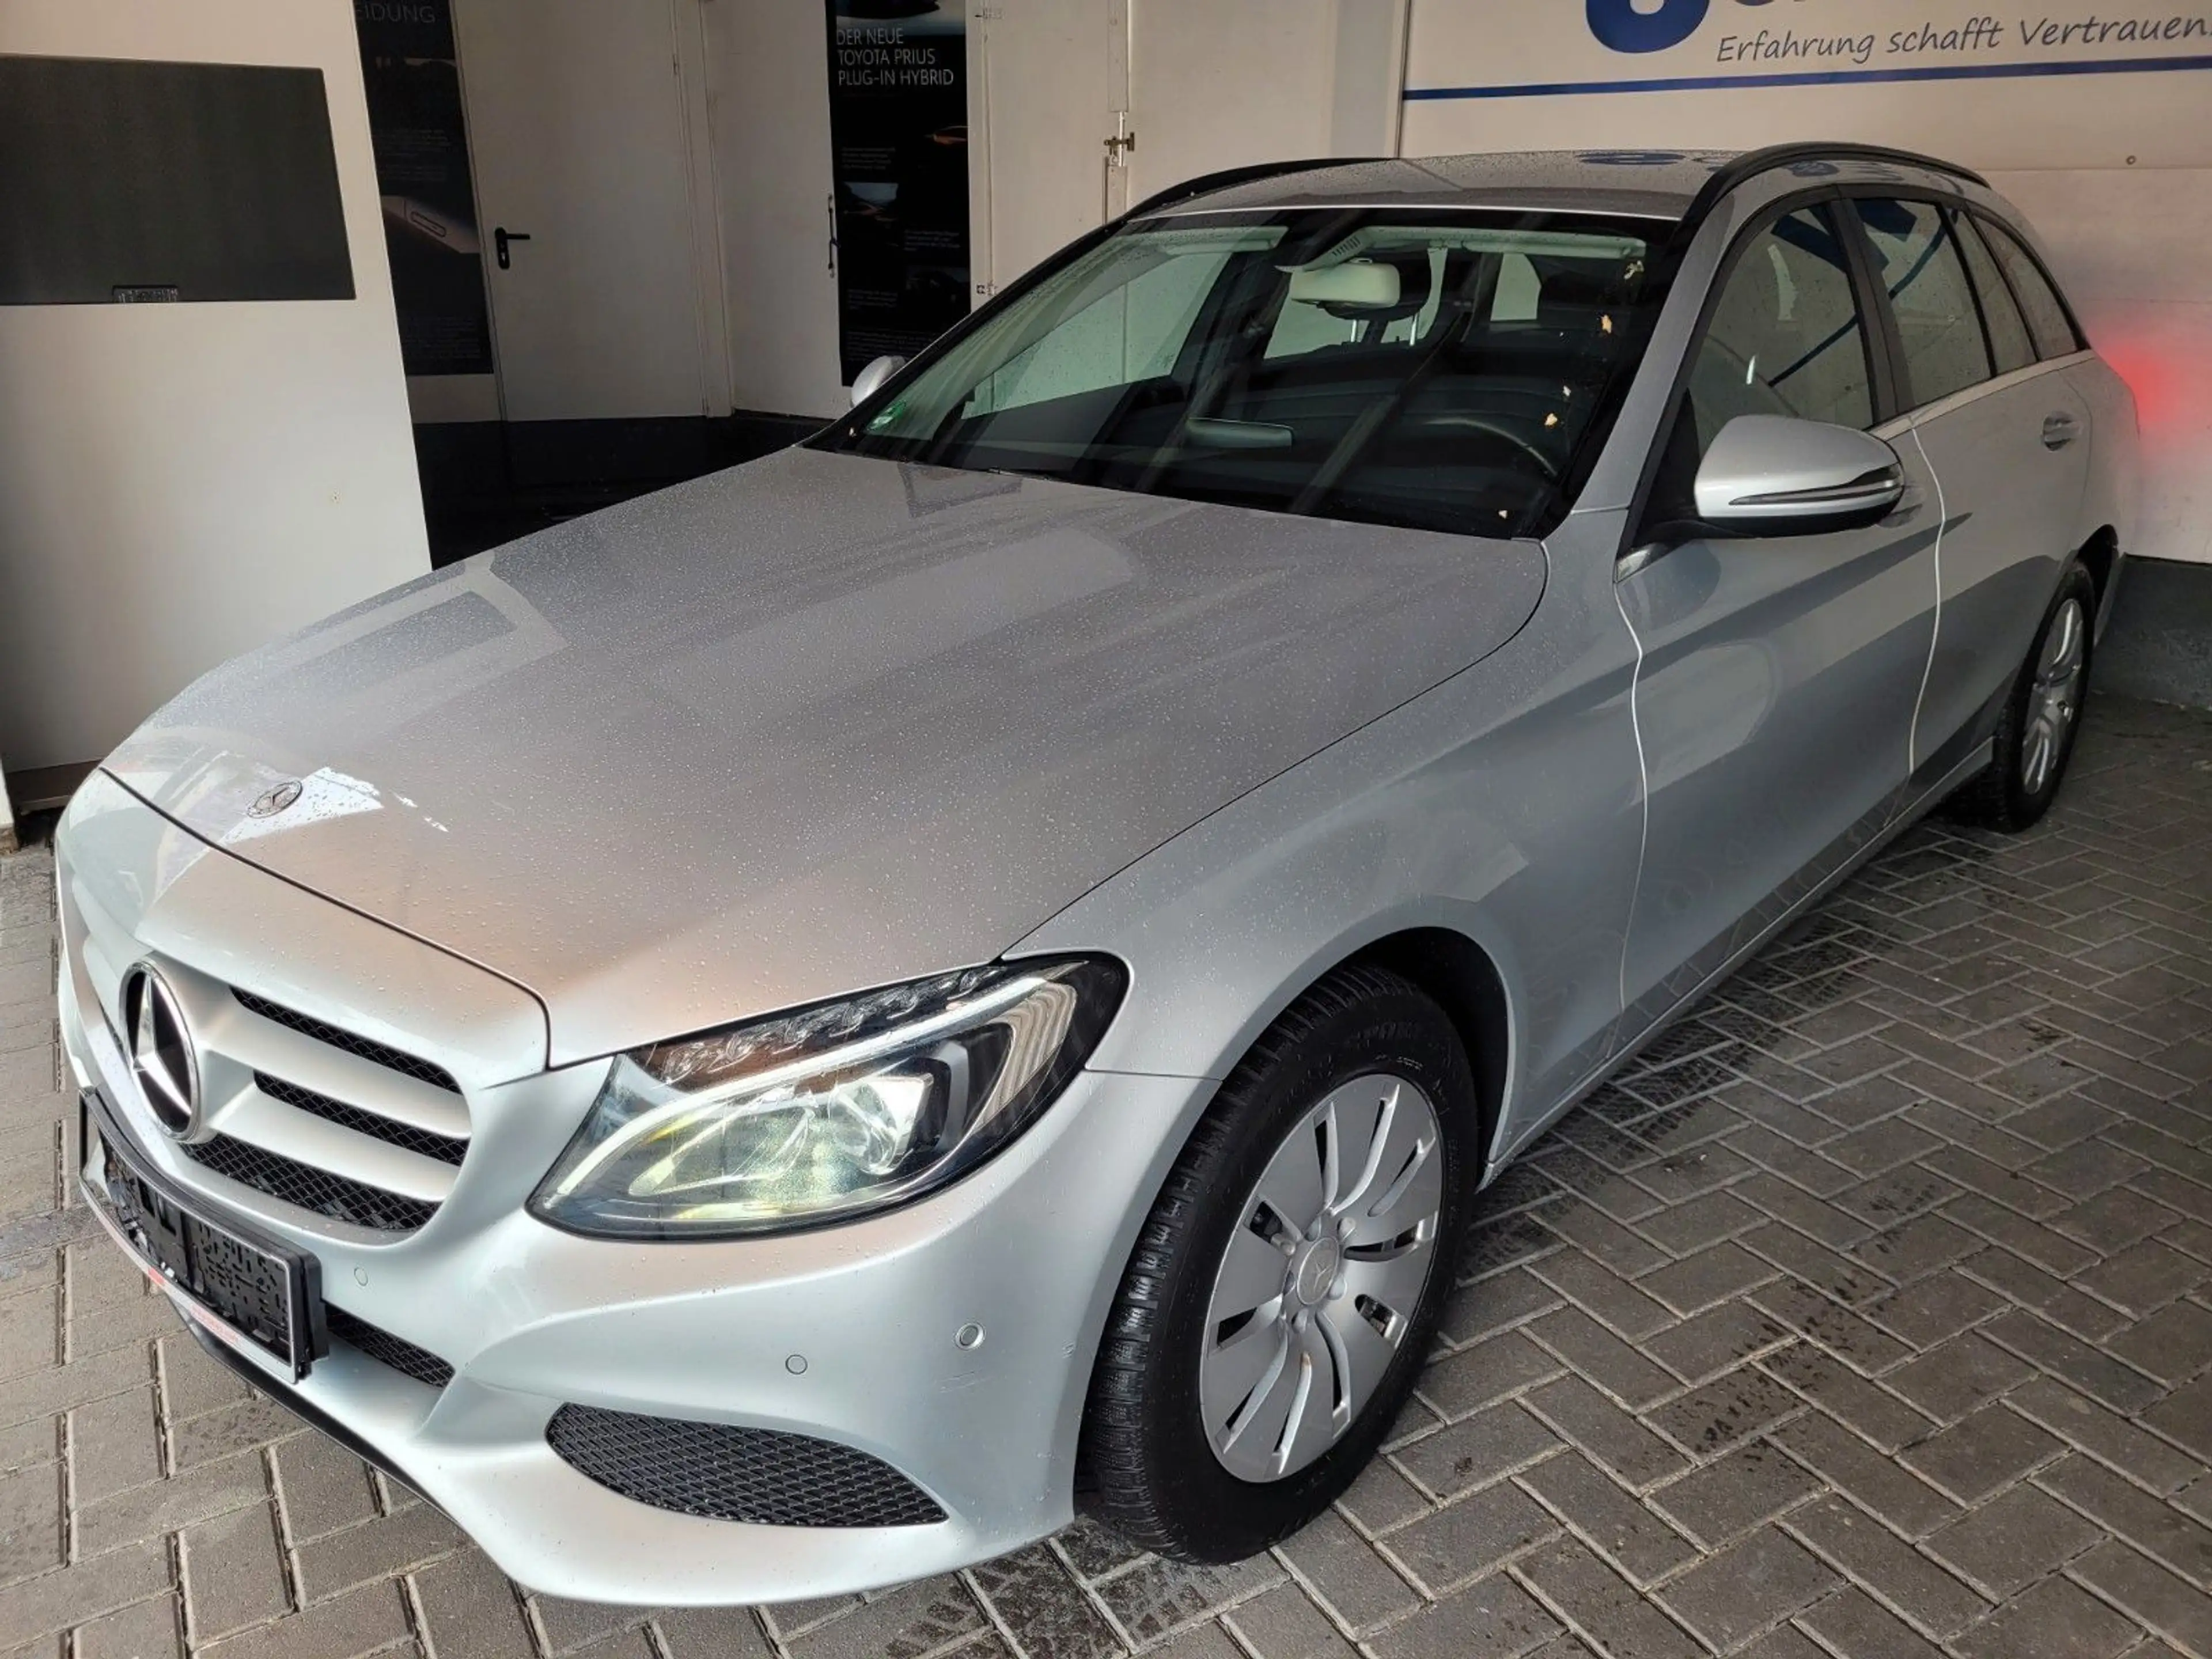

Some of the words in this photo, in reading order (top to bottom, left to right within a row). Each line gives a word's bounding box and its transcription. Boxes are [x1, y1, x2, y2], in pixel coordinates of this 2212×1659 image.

[836, 28, 862, 46] DER
[866, 27, 904, 45] NEUE
[1717, 29, 1876, 64] Erfahrung
[1887, 16, 2005, 54] schafft
[2019, 15, 2212, 46] Vertrauen
[837, 48, 890, 66] TOYOTA
[893, 48, 936, 65] PRIUS
[838, 69, 896, 86] PLUG-IN
[899, 69, 955, 86] HYBRID
